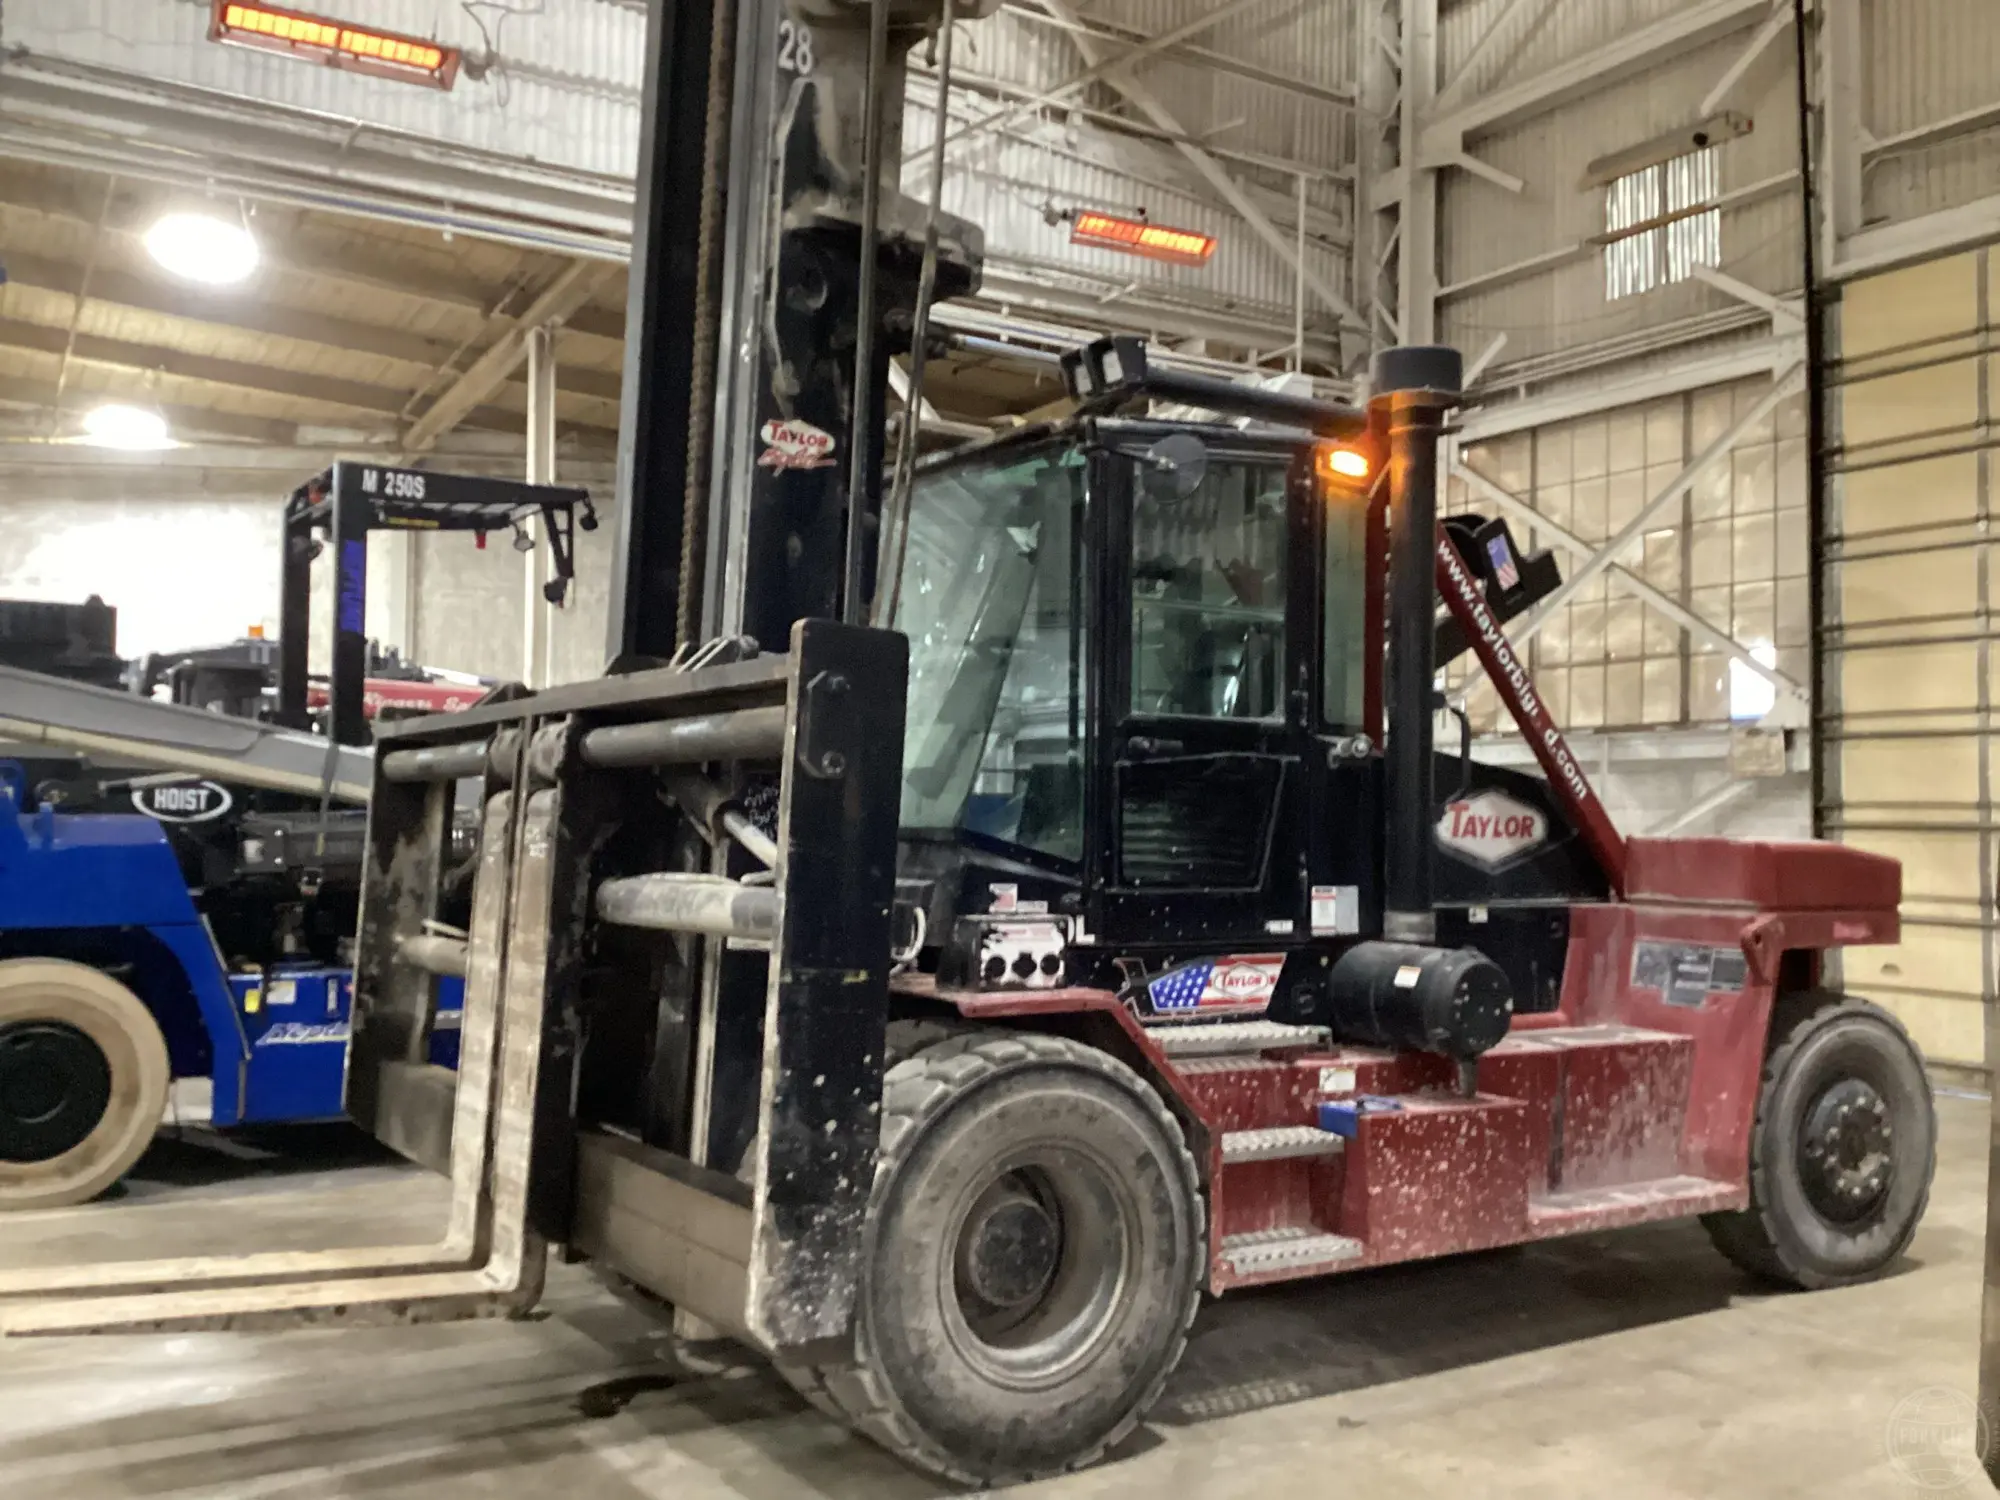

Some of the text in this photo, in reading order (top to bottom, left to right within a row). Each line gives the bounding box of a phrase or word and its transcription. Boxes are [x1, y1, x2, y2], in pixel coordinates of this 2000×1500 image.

[779, 20, 813, 74] 28
[768, 421, 829, 447] TAYLOR
[362, 469, 425, 499] M 250S
[154, 787, 210, 810] HOIST
[1446, 802, 1535, 838] TAYLOR
